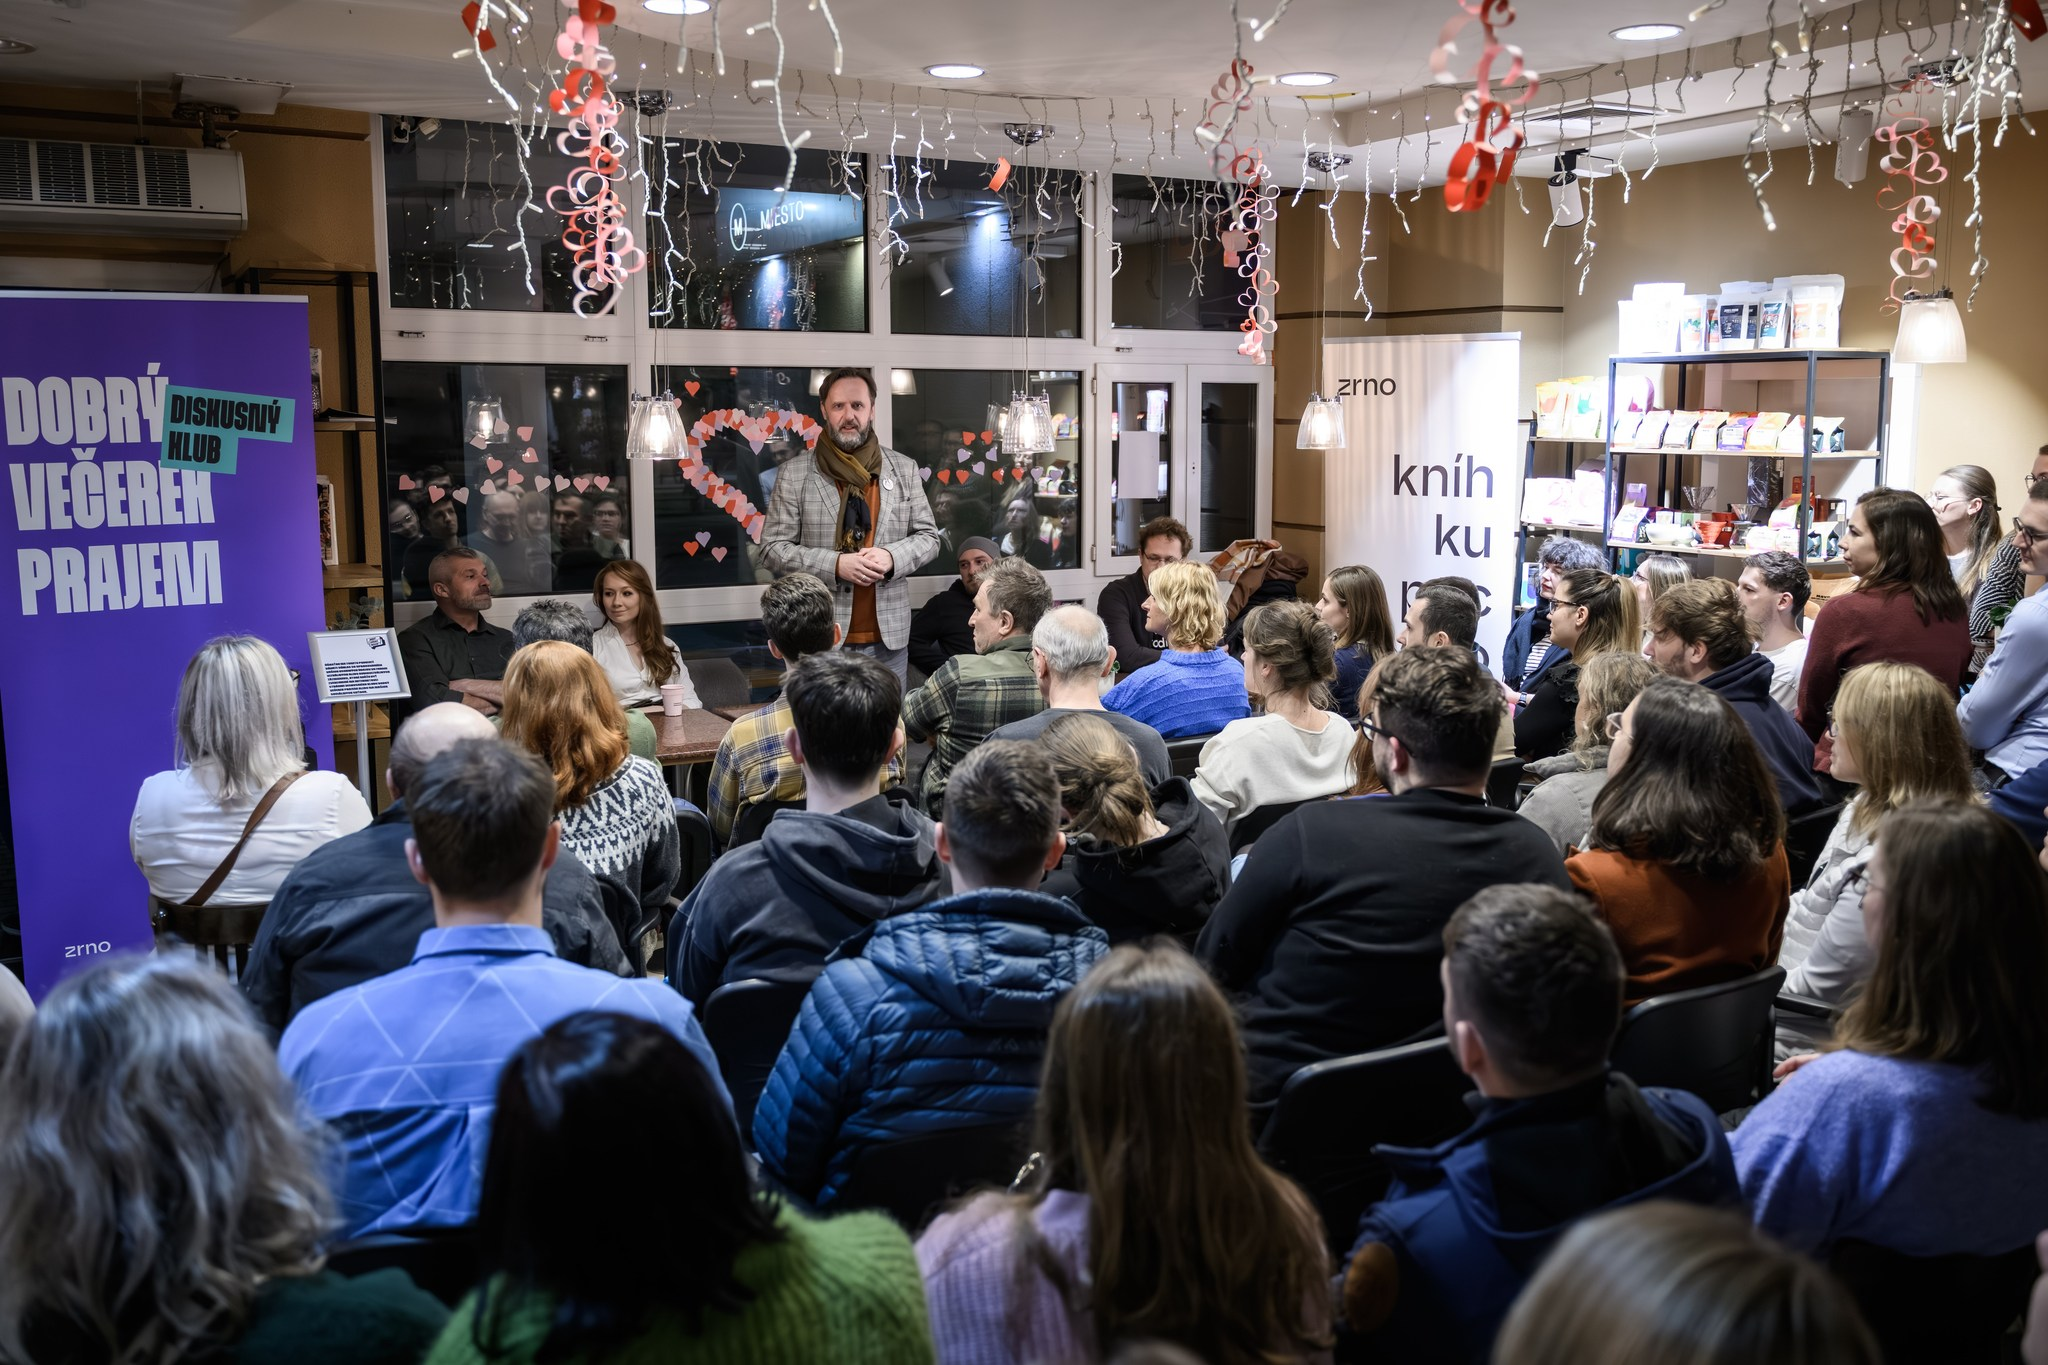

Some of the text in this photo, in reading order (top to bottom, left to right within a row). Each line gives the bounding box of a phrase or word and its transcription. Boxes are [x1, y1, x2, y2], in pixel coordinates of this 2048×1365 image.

[734, 217, 743, 237] M
[760, 200, 805, 230] MIESTO
[1, 362, 169, 446] DOBRÝ
[1338, 377, 1397, 397] zrno
[170, 393, 282, 435] DISKUSNÝ
[167, 430, 222, 465] KLUB
[9, 447, 216, 532] VEČEREK
[1393, 452, 1494, 499] kníh
[1434, 513, 1492, 559] ku
[17, 540, 223, 616] PRAJEM
[64, 940, 112, 959] zrno
